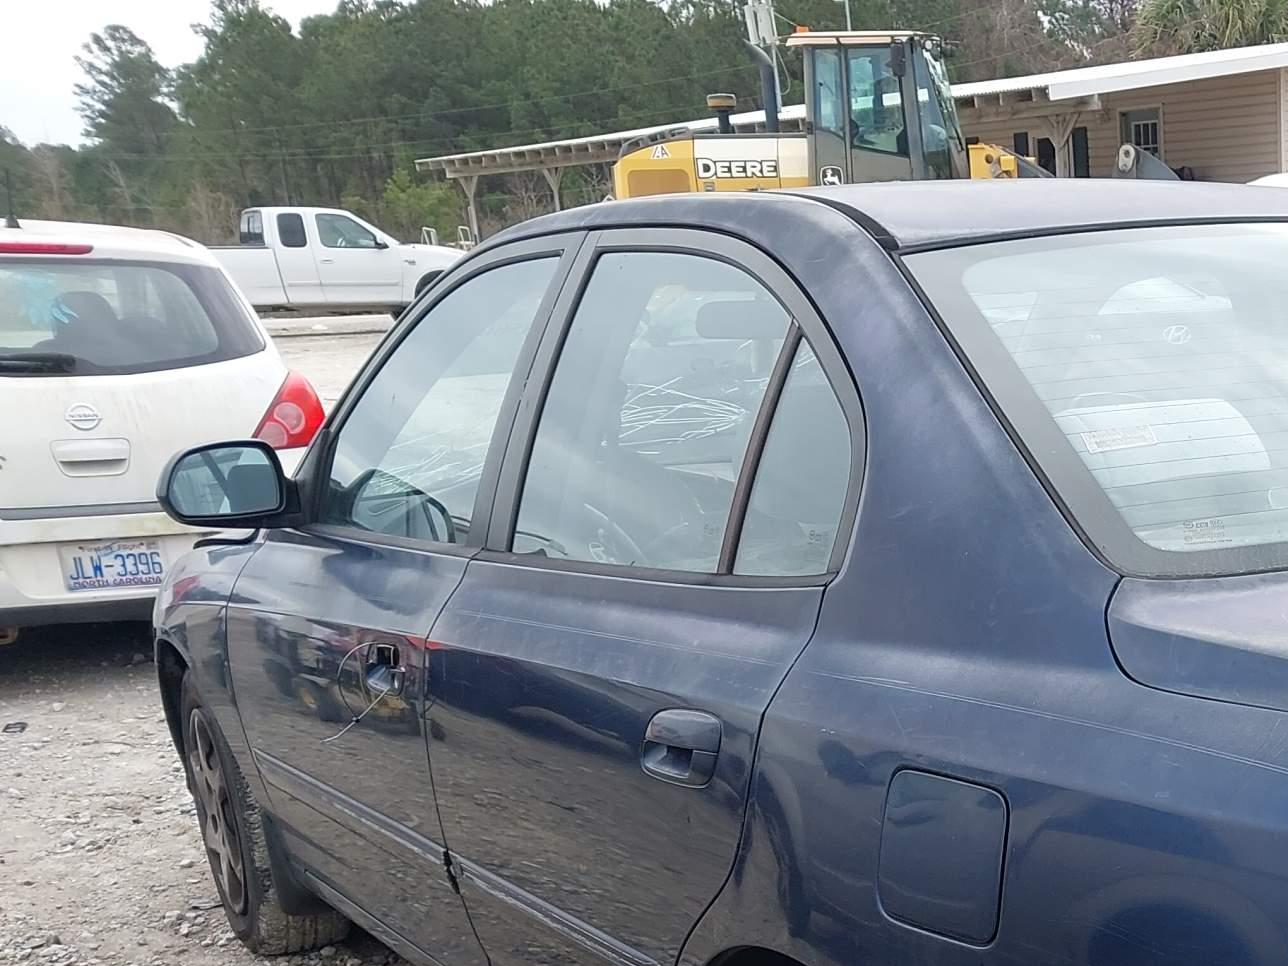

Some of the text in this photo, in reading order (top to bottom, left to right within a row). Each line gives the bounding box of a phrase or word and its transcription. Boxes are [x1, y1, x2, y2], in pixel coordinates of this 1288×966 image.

[695, 157, 779, 180] DEERE
[69, 551, 164, 581] JLW-3396
[112, 575, 163, 587] CAROLINA
